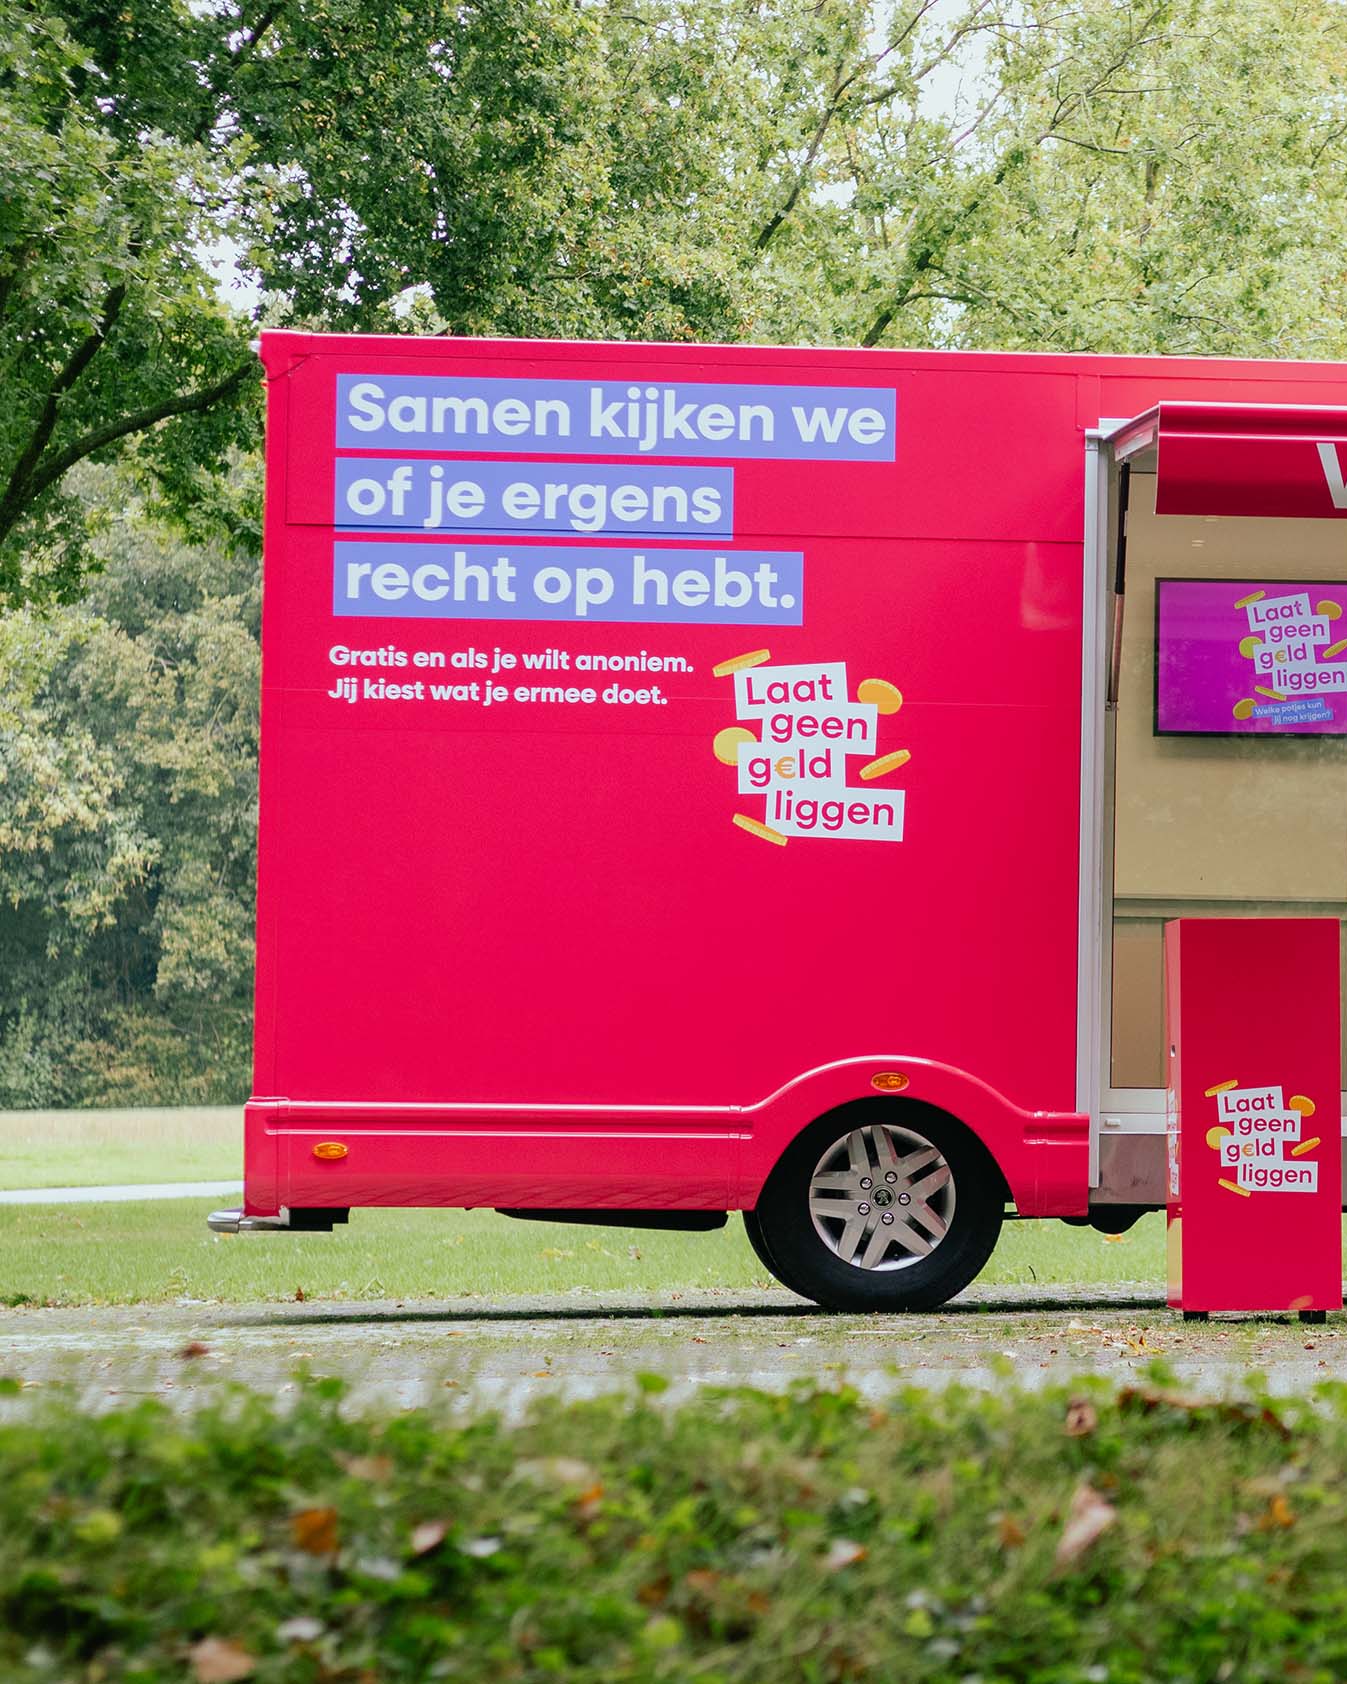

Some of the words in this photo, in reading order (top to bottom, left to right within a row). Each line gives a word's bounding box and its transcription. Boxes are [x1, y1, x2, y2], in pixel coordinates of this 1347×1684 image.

[349, 383, 570, 436] Samen
[590, 387, 774, 451] kijken
[792, 407, 886, 444] we
[347, 466, 412, 515] of
[424, 465, 485, 528] je
[502, 483, 721, 531] ergens
[347, 552, 516, 601] recht
[534, 567, 614, 616] op
[633, 556, 795, 608] hebt.
[1253, 600, 1303, 623] Laat
[1269, 623, 1325, 642] geen
[329, 645, 408, 667] Gratis
[413, 652, 445, 668] en
[450, 648, 488, 668] als
[492, 648, 517, 674] je
[522, 649, 569, 670] wilt
[575, 651, 693, 672] anoniem.
[328, 678, 357, 704] Jij
[364, 678, 424, 701] kiest
[430, 683, 479, 701] wat
[483, 680, 508, 706] je
[514, 687, 596, 704] ermee
[602, 684, 667, 705] doet.
[746, 674, 833, 705] Laat
[1277, 668, 1345, 690] liggen
[1255, 706, 1280, 715] Welke
[1281, 703, 1306, 714] potjes
[1307, 701, 1322, 709] kun
[1300, 711, 1331, 721] krijgen?
[770, 713, 868, 743] geen
[775, 790, 894, 830] liggen
[1224, 1093, 1275, 1113] Laat
[1238, 1117, 1296, 1135] geen
[1242, 1163, 1312, 1187] liggen
